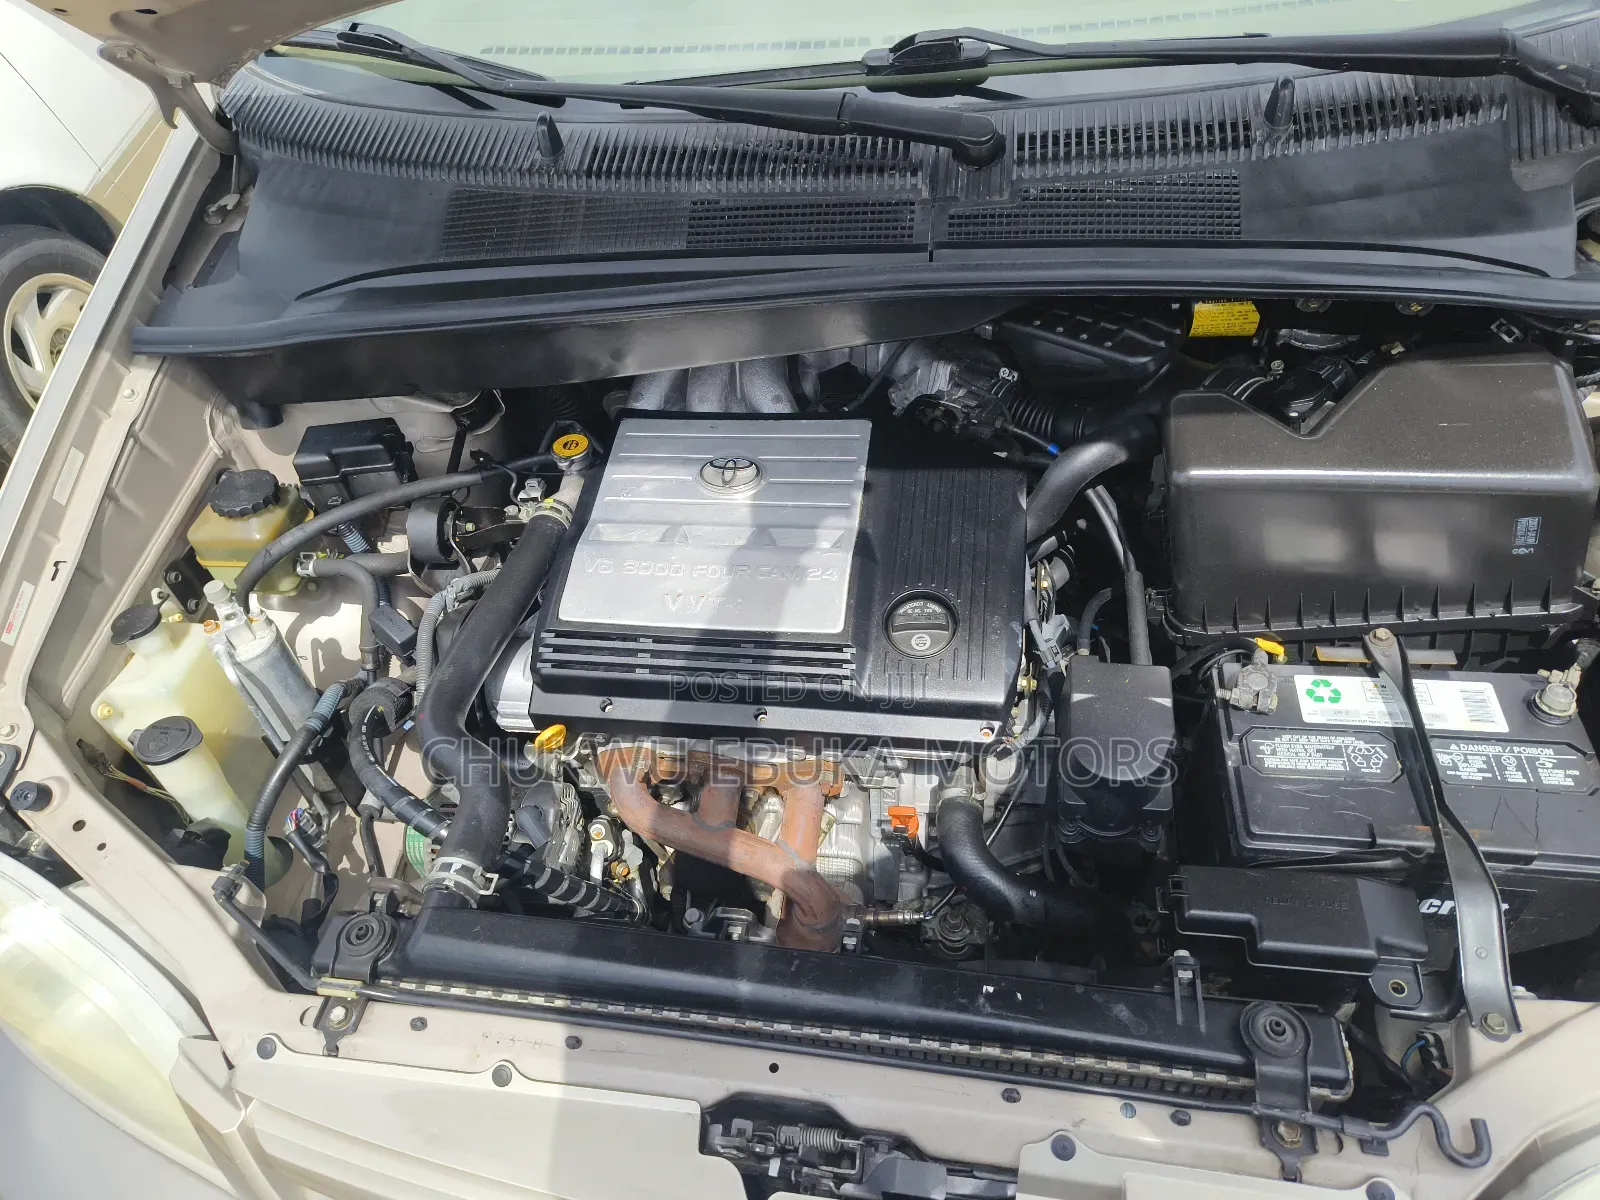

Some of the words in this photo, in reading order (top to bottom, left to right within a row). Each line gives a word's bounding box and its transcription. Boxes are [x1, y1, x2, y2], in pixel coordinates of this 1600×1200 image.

[584, 558, 614, 574] V6
[622, 560, 686, 576] 3000
[692, 564, 751, 579] FOUR
[755, 565, 800, 580] CAM
[1460, 744, 1503, 752] DANGER
[1513, 747, 1554, 755] POISON
